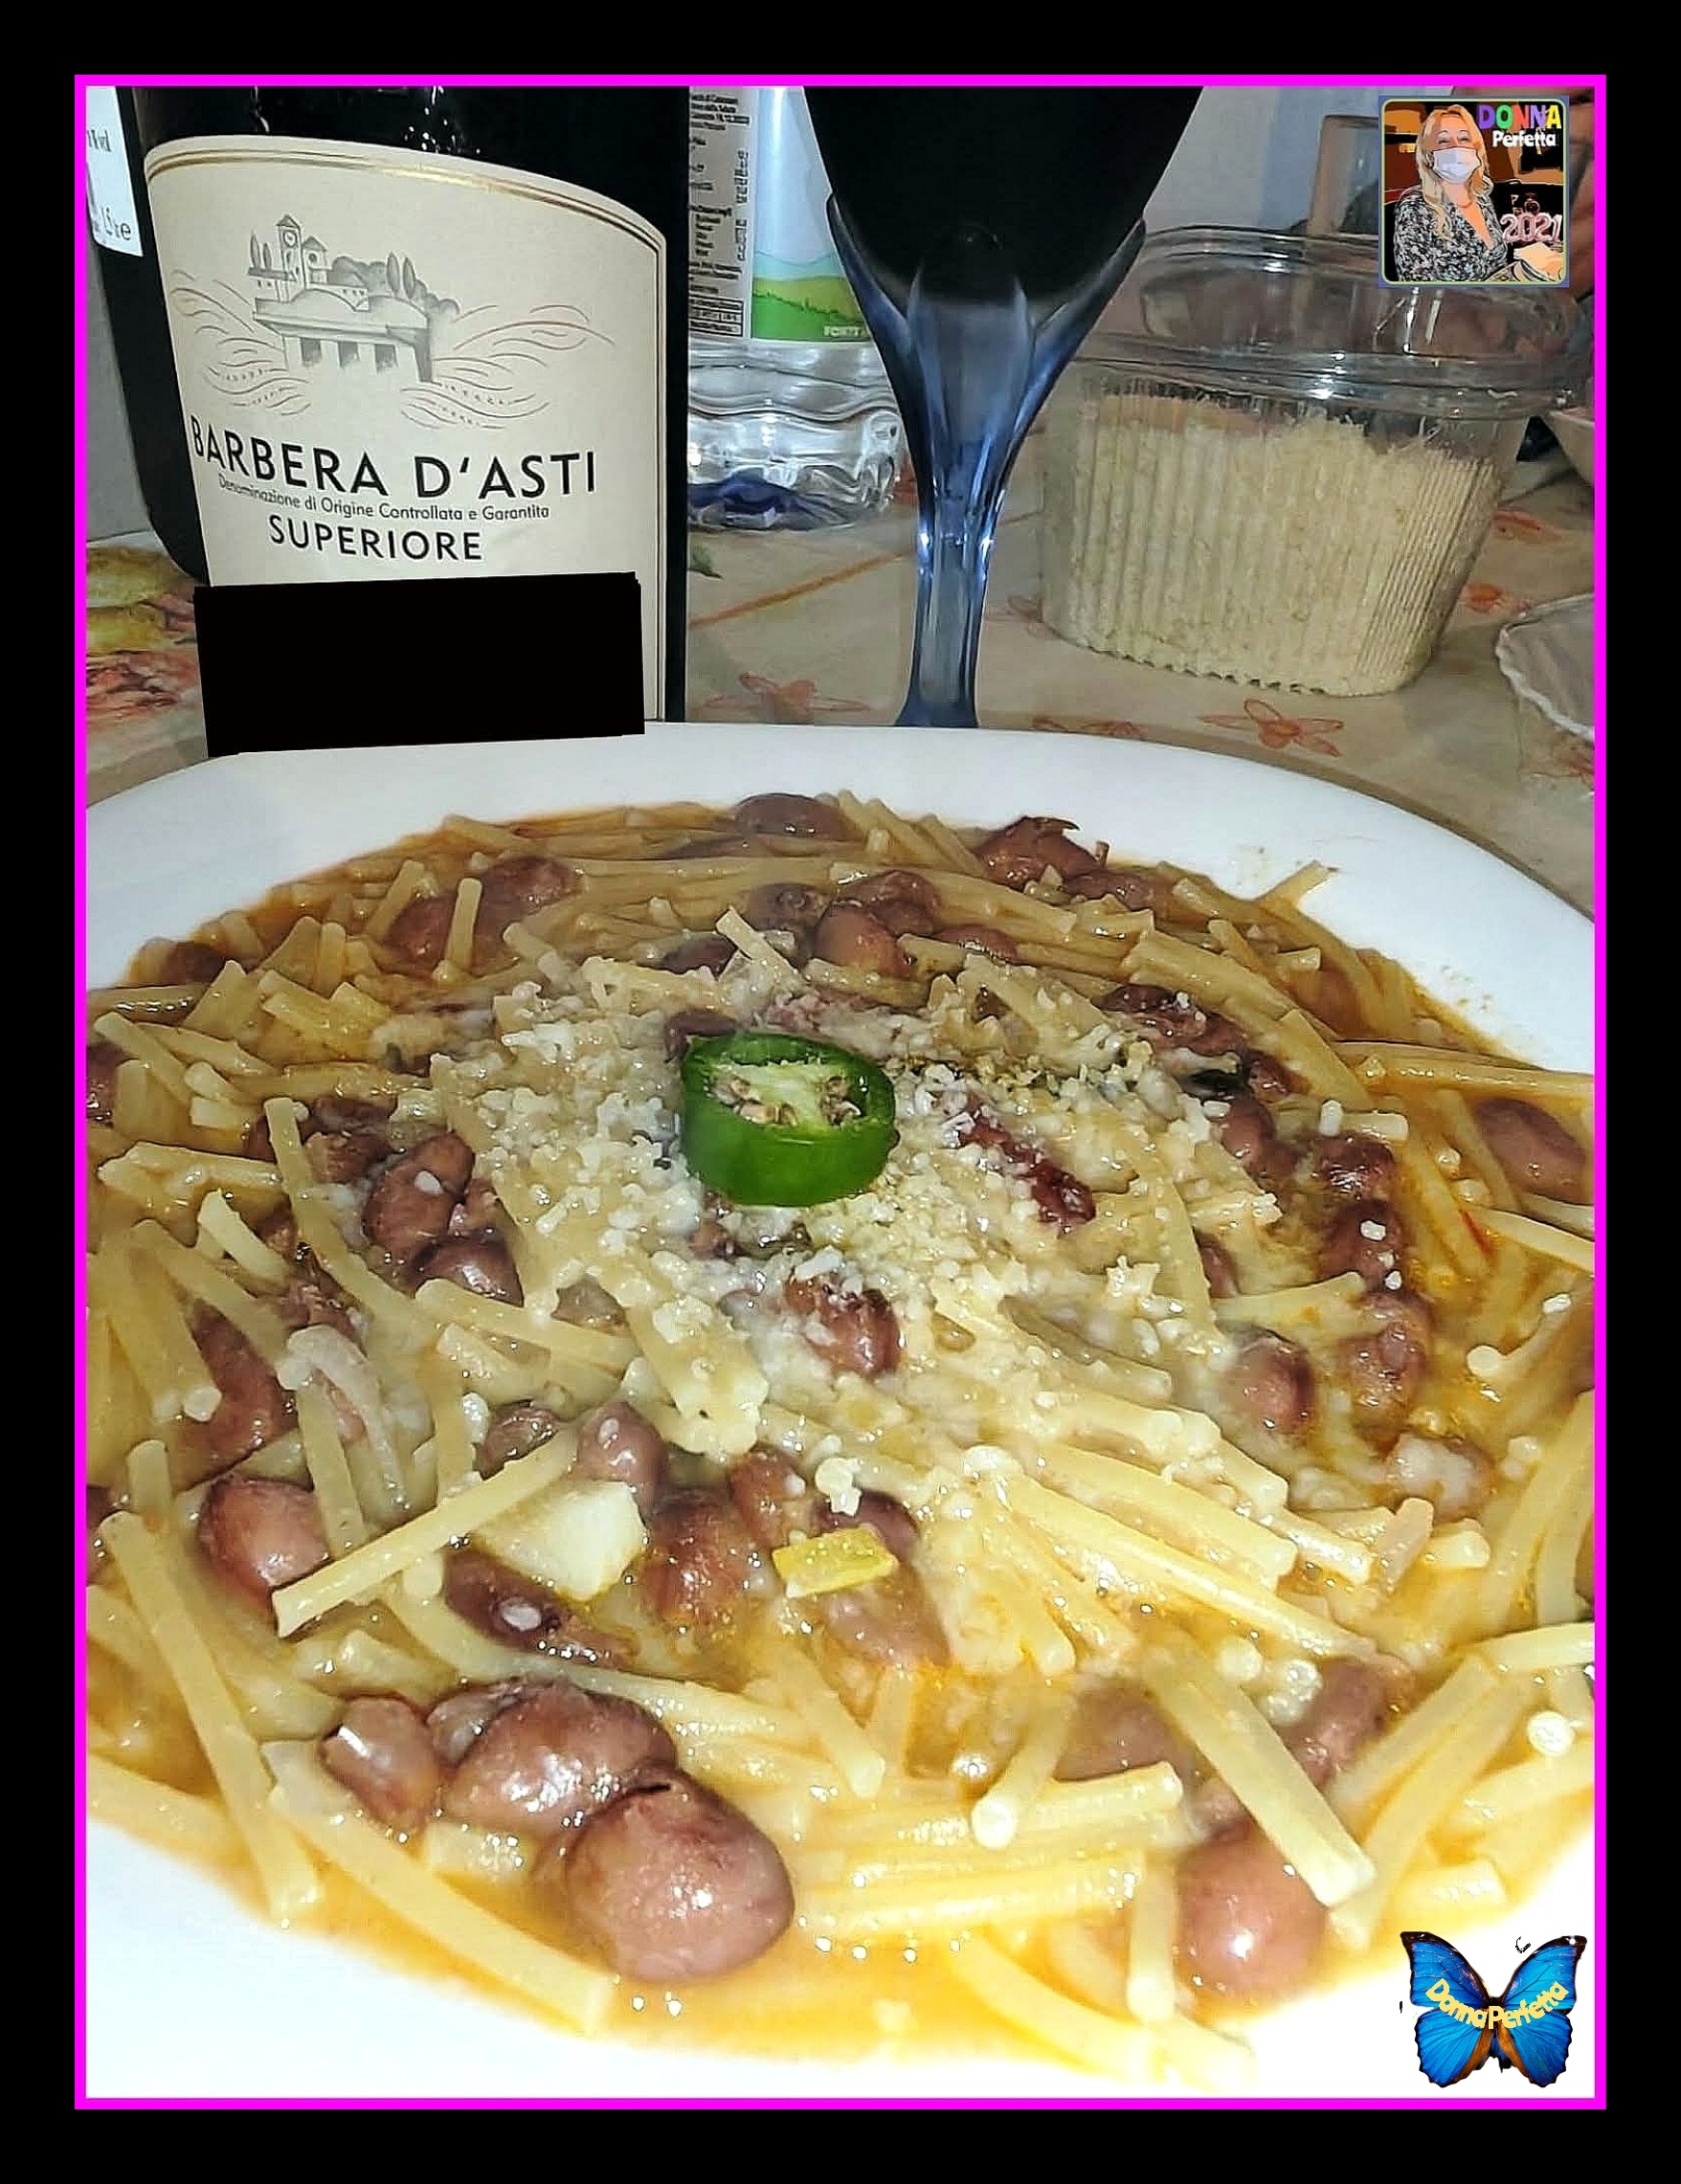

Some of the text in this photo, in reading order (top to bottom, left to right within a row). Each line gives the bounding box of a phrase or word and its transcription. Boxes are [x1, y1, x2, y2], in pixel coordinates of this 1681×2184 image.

[191, 414, 595, 500] BARBERA D'ASTI
[218, 473, 549, 521] Denominazione di Origine Controllata e Garantita
[269, 514, 482, 561] SUPERIORE
